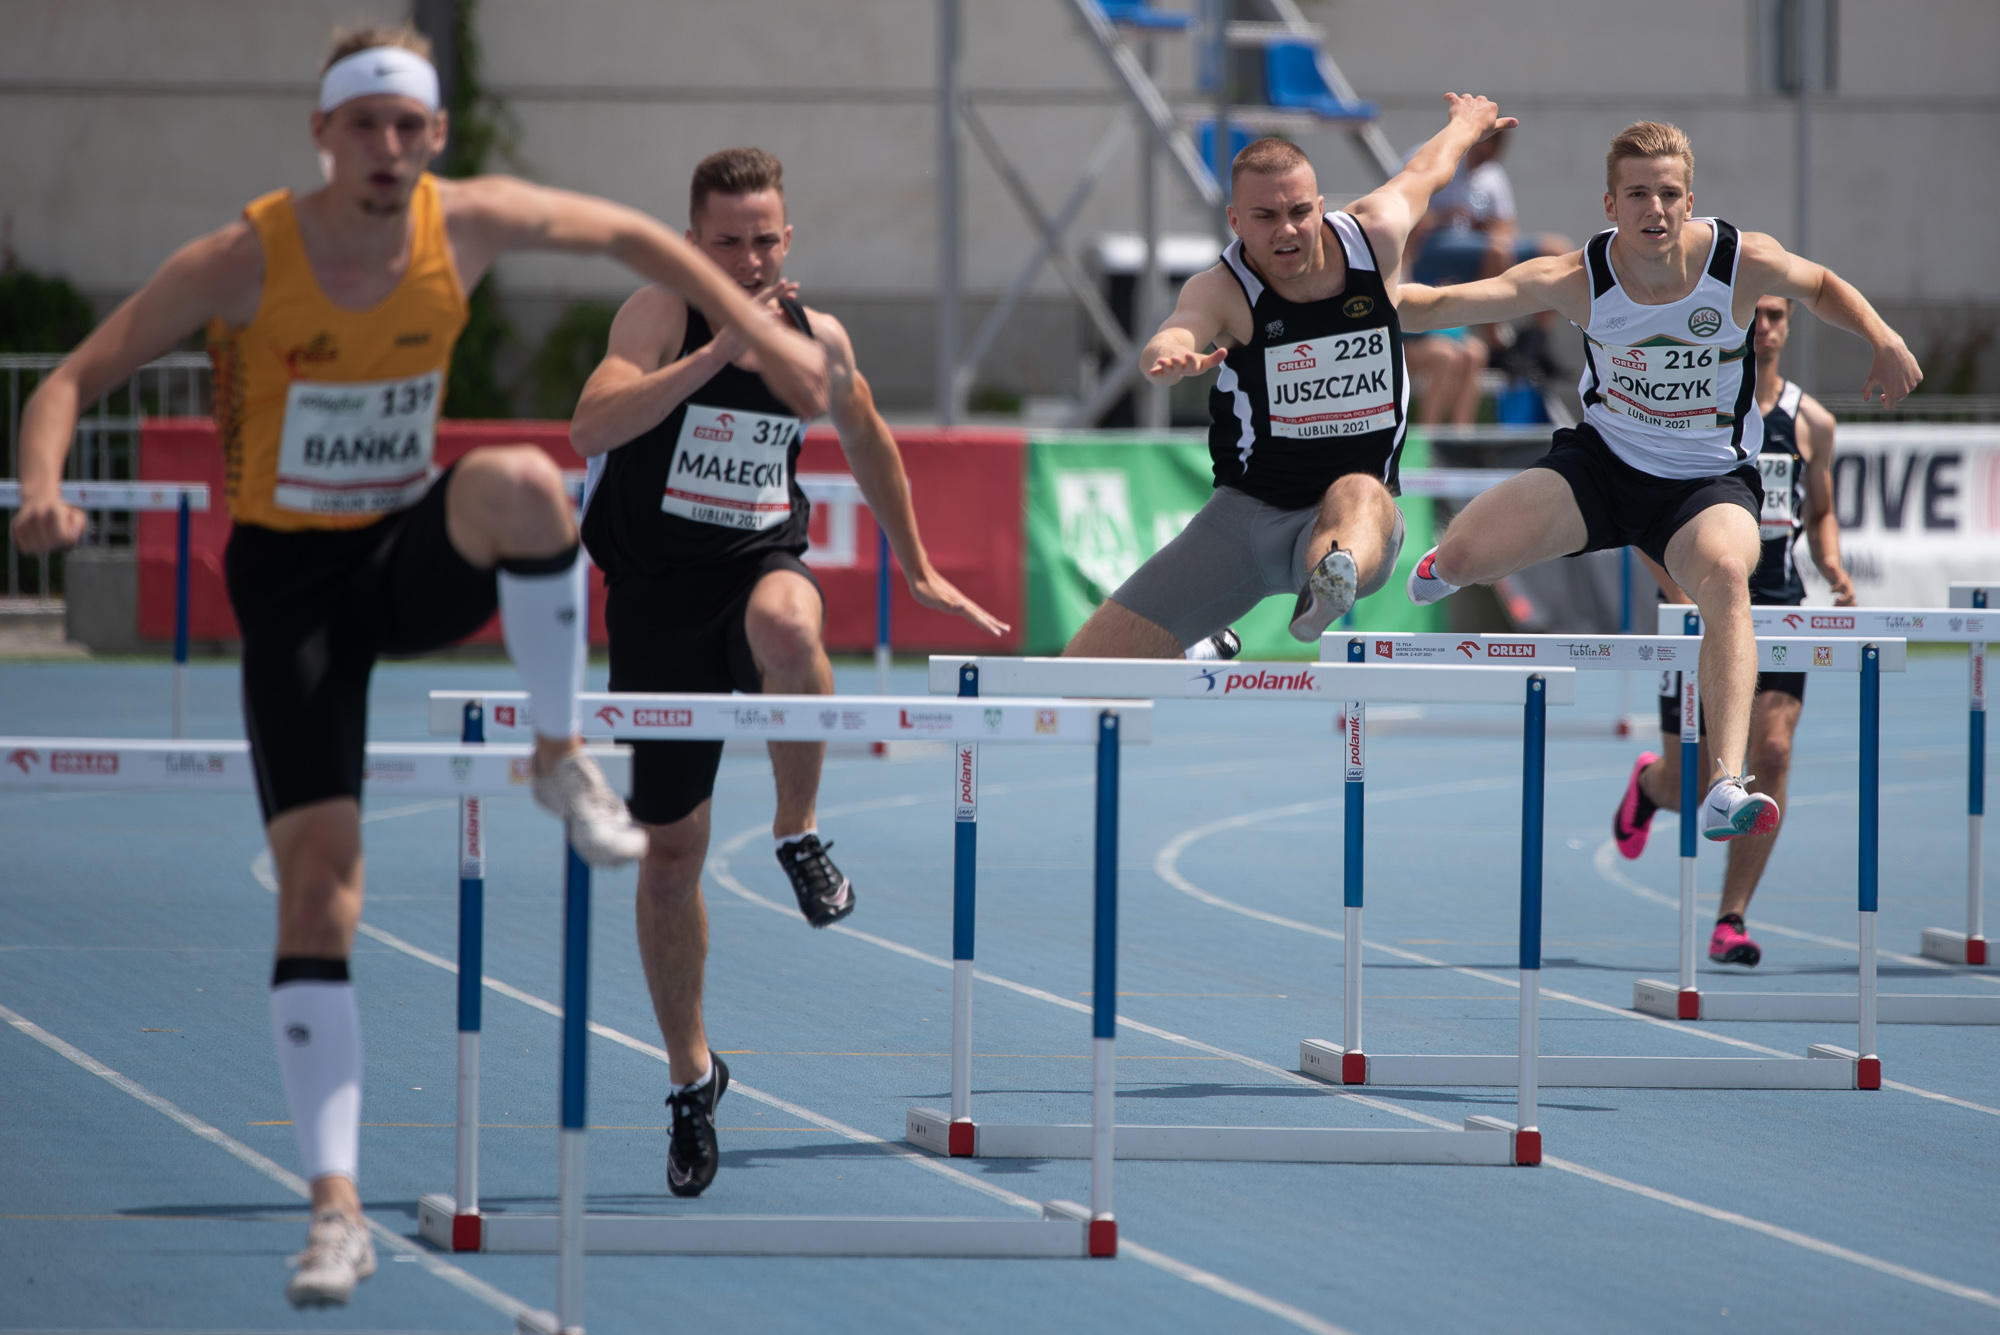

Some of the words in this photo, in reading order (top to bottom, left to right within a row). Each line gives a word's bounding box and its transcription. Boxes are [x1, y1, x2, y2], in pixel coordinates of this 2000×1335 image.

[1693, 311, 1717, 325] RKS
[1334, 333, 1384, 362] 228
[1279, 360, 1314, 372] ORLEN
[1613, 358, 1645, 371] ORLEN
[1664, 349, 1712, 370] 216
[1273, 368, 1388, 405] JUSZCZAK
[1612, 371, 1712, 401] JOŃCZYK
[1285, 417, 1304, 425] PZLA
[1304, 412, 1353, 423] MISTRZOSTWA
[1353, 407, 1377, 417] POLSKI
[1377, 405, 1390, 413] U20
[1628, 406, 1662, 427] LUBLIN
[1665, 419, 1691, 429] 2021
[752, 420, 794, 446] 311
[1297, 424, 1339, 437] LUBLIN
[1342, 420, 1370, 434] 2021
[676, 450, 782, 488] MAŁECKI
[690, 506, 735, 524] LUBLIN
[736, 514, 762, 528] 2021
[1812, 617, 1854, 629] ORLEN
[1490, 645, 1534, 656] ORLEN
[1224, 670, 1316, 694] polanik
[636, 711, 691, 725] ORLEN
[1348, 715, 1362, 766] polanik
[960, 748, 974, 804] polanik
